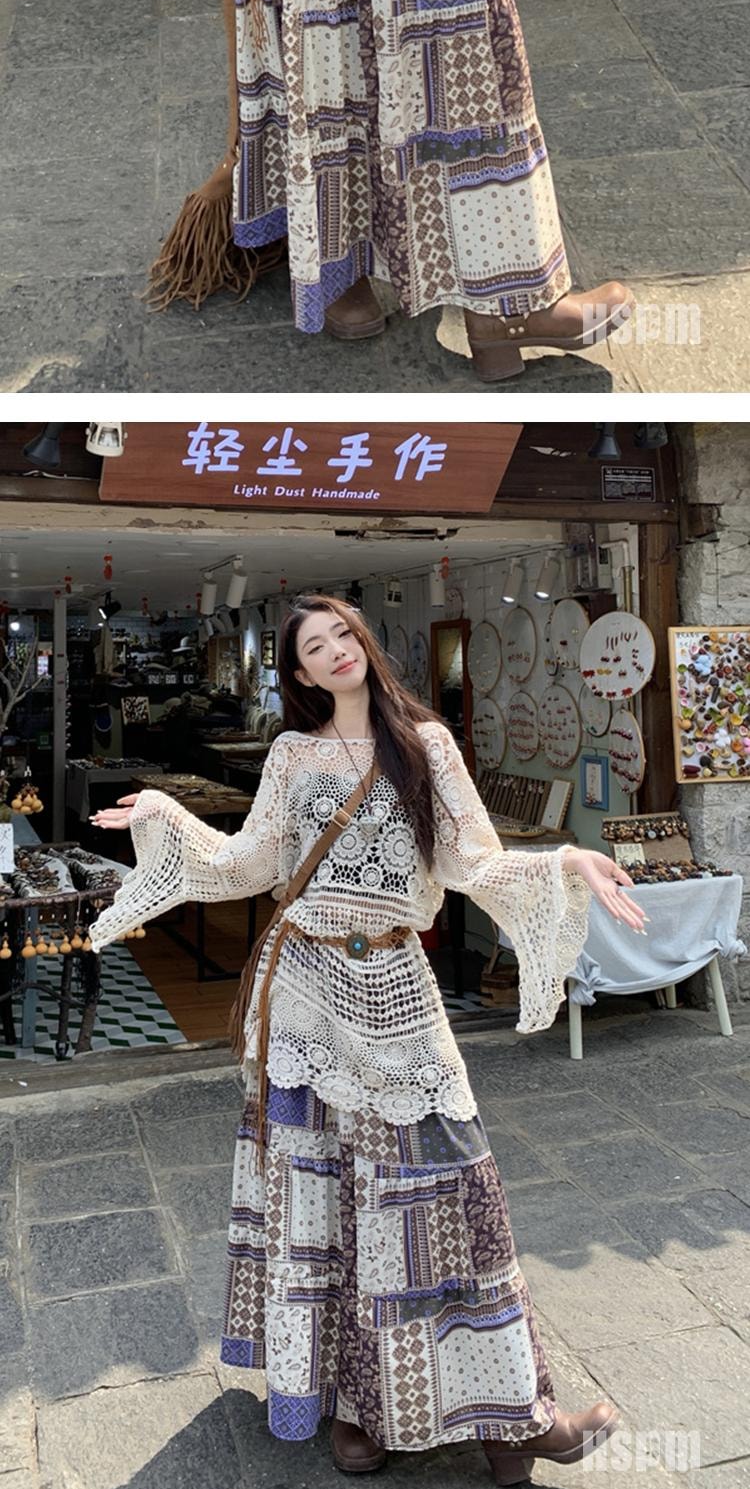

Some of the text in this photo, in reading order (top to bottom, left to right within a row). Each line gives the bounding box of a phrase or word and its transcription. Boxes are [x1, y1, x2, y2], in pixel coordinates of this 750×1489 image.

[182, 422, 448, 483] 轻尘手作
[233, 484, 381, 500] Light Dust Handmade
